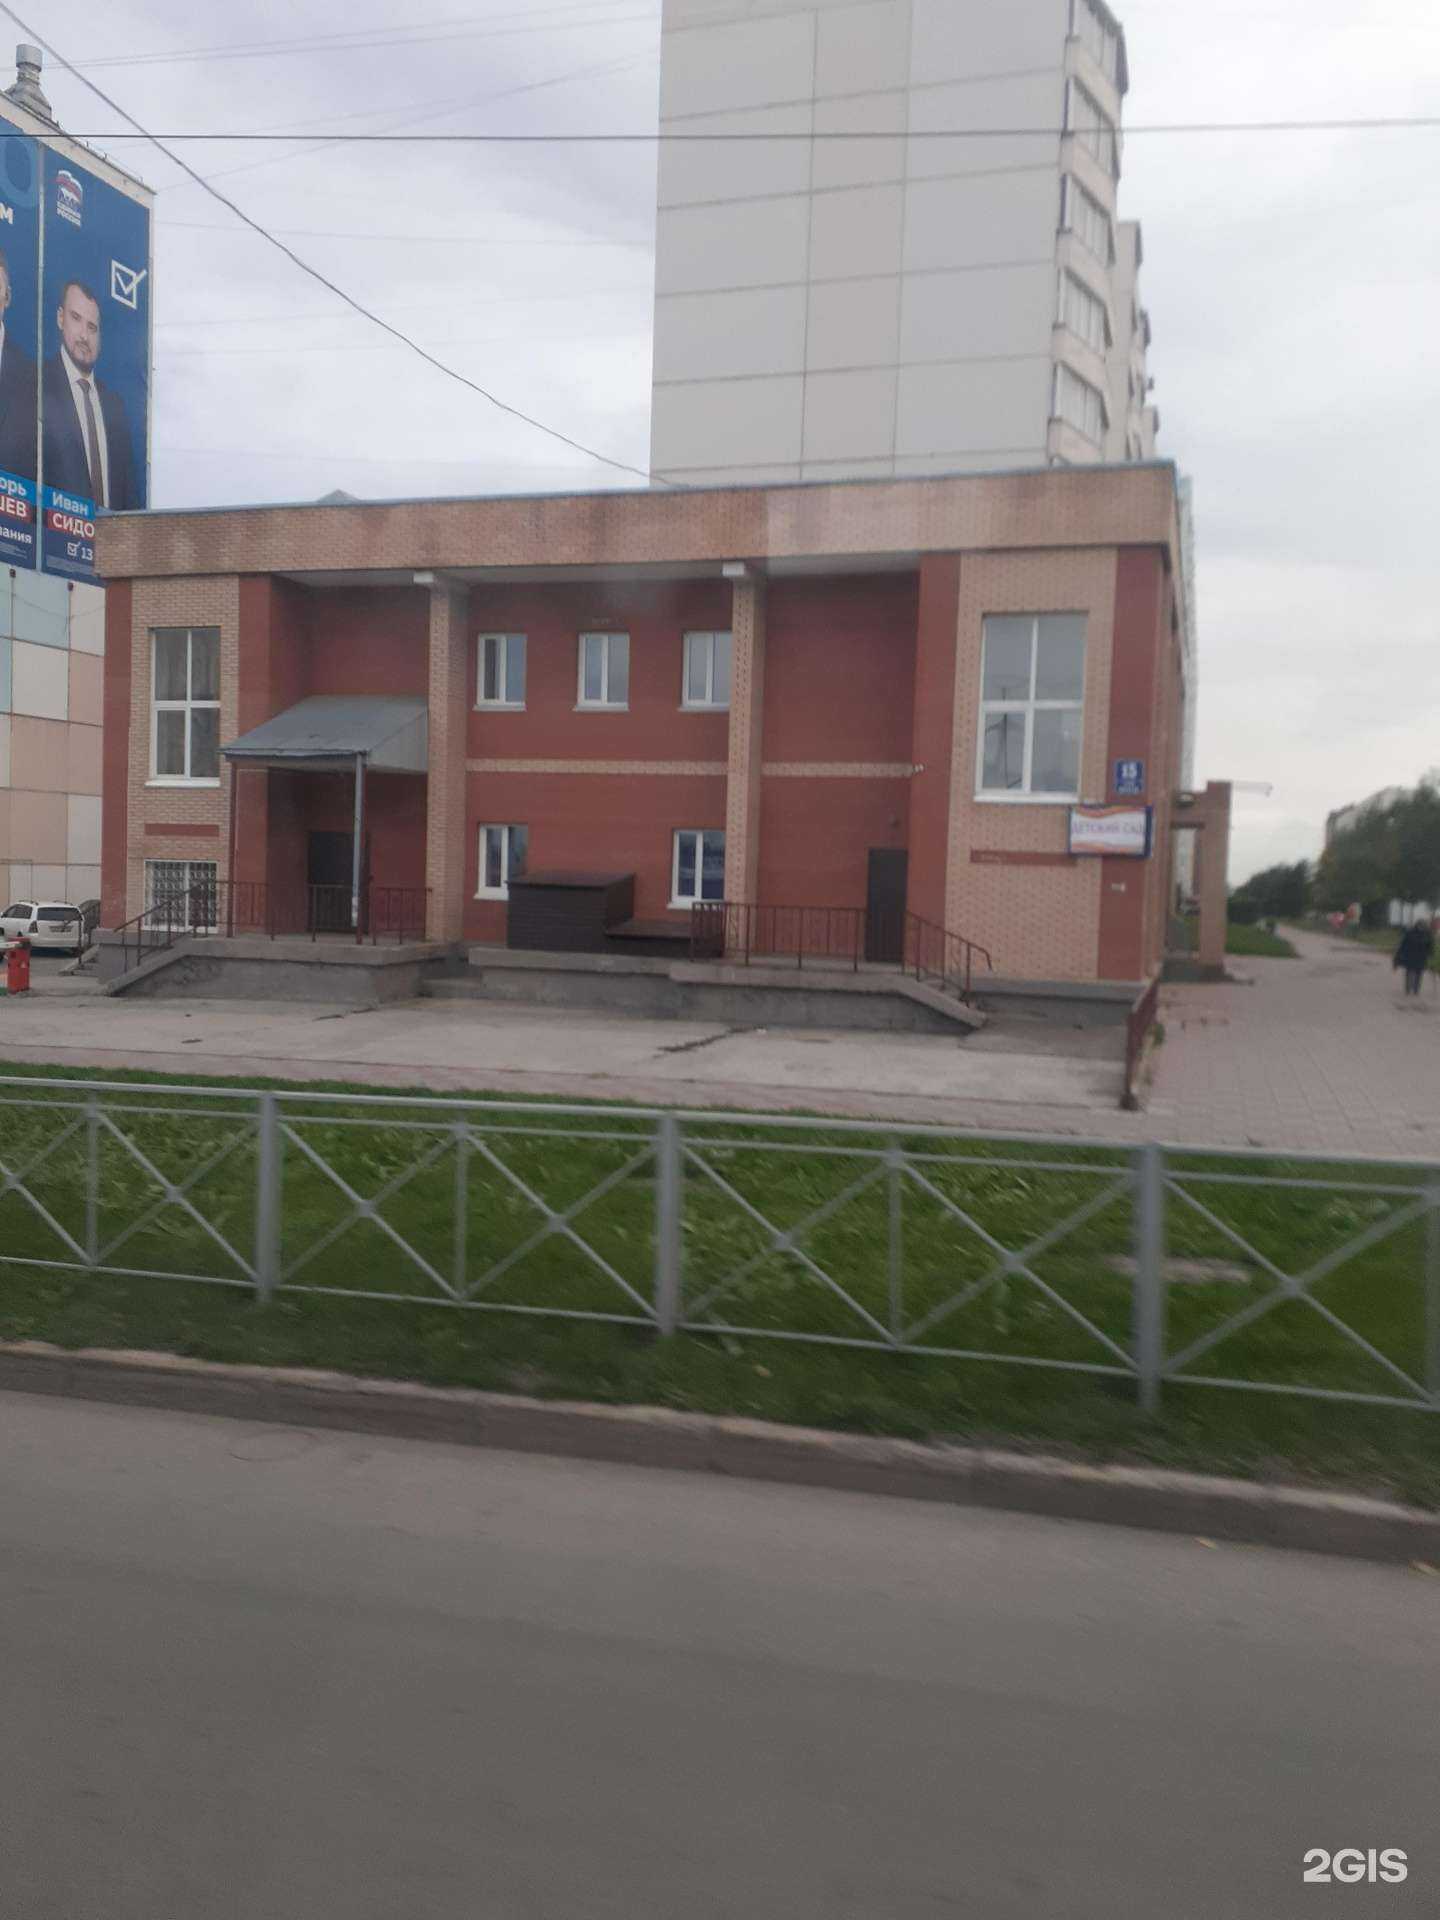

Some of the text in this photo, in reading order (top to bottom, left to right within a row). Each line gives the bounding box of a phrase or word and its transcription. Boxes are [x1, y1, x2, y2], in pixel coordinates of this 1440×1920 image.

[52, 491, 88, 516] Иван
[0, 525, 32, 544] ания
[52, 512, 95, 538] СИДО
[81, 546, 93, 561] 13
